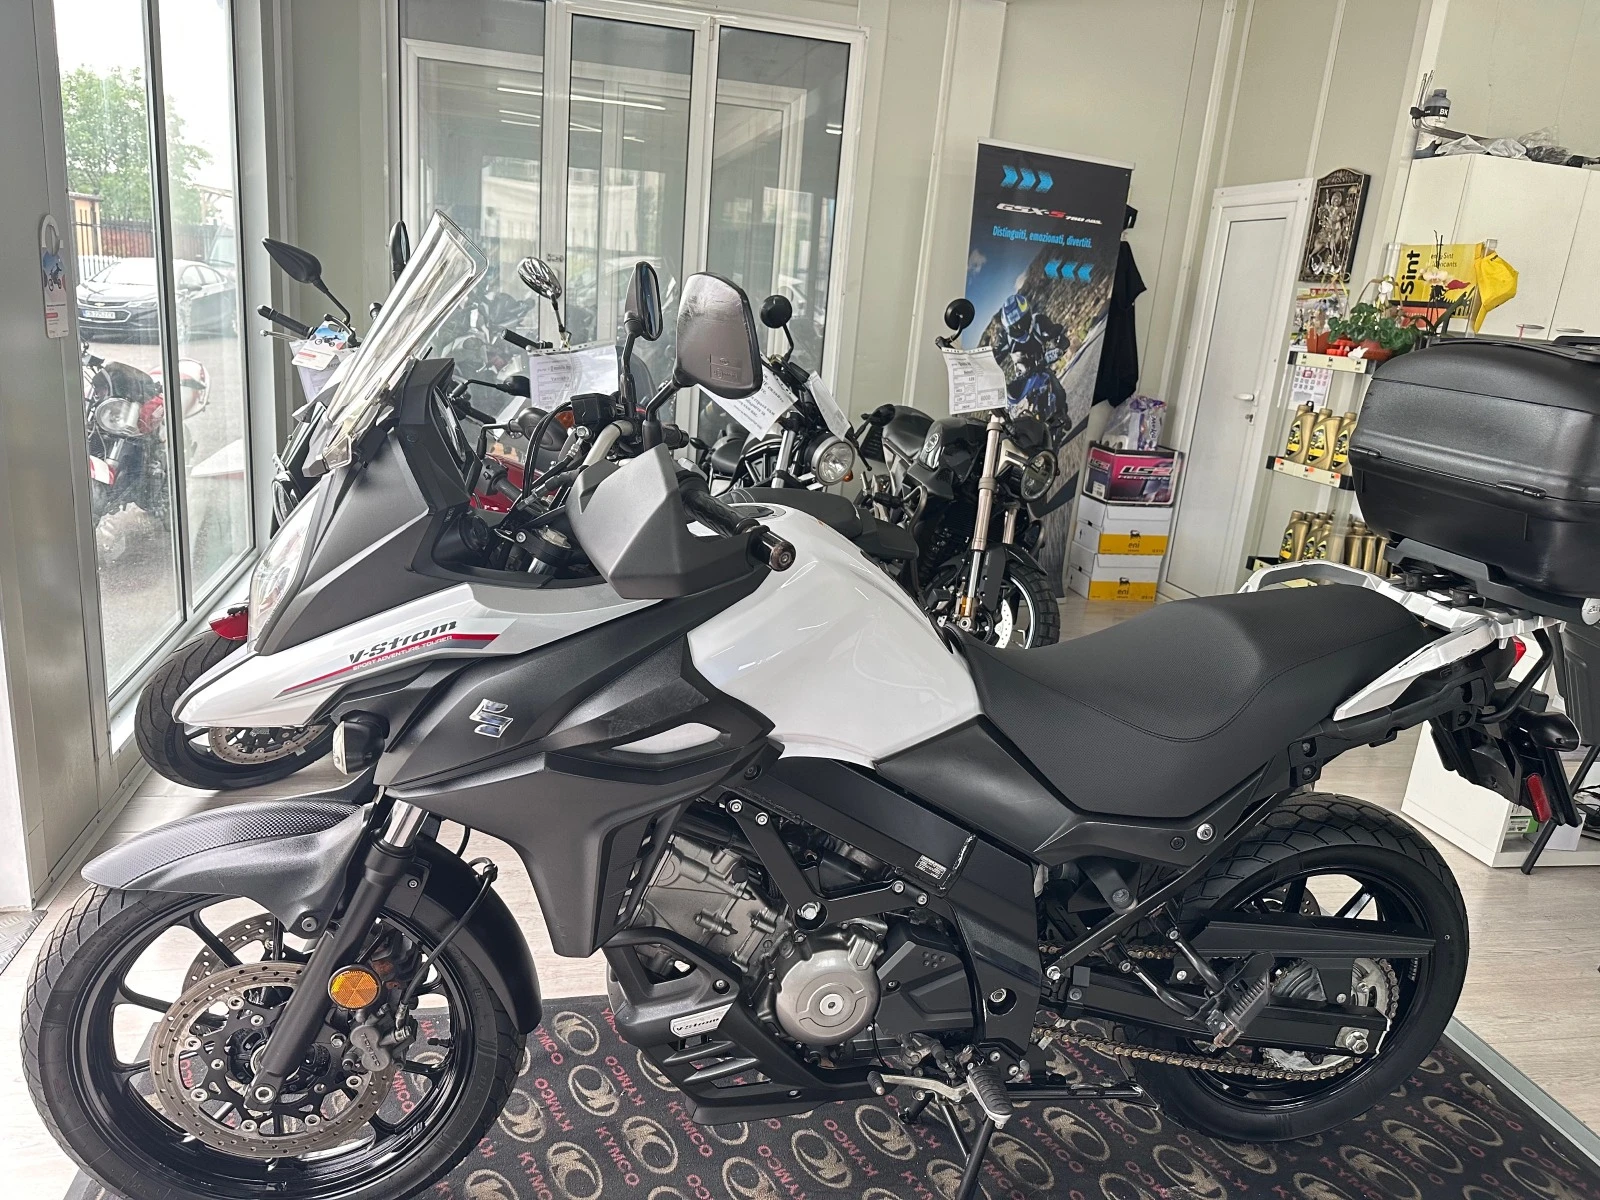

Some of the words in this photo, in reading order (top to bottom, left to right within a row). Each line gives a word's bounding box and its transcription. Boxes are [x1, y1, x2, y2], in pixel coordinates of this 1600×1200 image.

[993, 225, 1028, 241] Distinguiti,
[1029, 231, 1065, 247] emozionati,
[1066, 235, 1092, 249] divertiti.
[349, 620, 457, 664] V-Strom
[352, 656, 377, 671] SPORT
[376, 645, 421, 664] ADVENTURE
[421, 635, 453, 649] TOURER
[534, 1078, 574, 1132] KYMCO
[604, 1055, 645, 1106] KYMCO
[667, 1100, 714, 1158] KYMCO
[823, 1118, 879, 1177] KYMCO
[1019, 1116, 1085, 1173] KYMCO
[518, 1151, 554, 1200] KYMC
[595, 1126, 640, 1188] KYMCO
